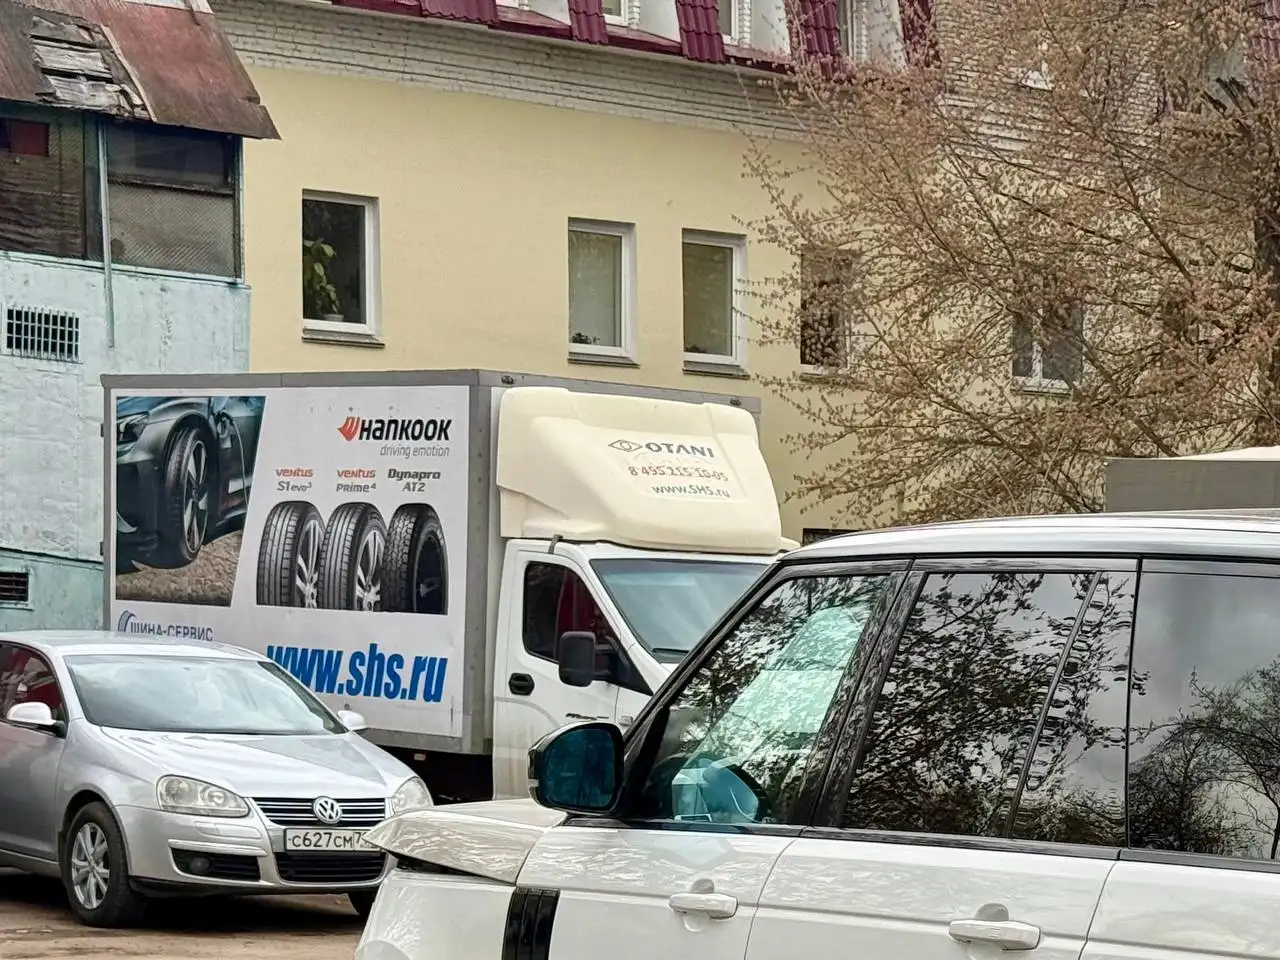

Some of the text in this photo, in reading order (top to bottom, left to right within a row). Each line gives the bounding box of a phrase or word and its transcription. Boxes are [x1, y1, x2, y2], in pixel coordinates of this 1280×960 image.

[380, 443, 450, 459] driving emotion
[645, 442, 715, 458] OTANI
[387, 468, 441, 482] Dynapro
[401, 482, 426, 493] AT2
